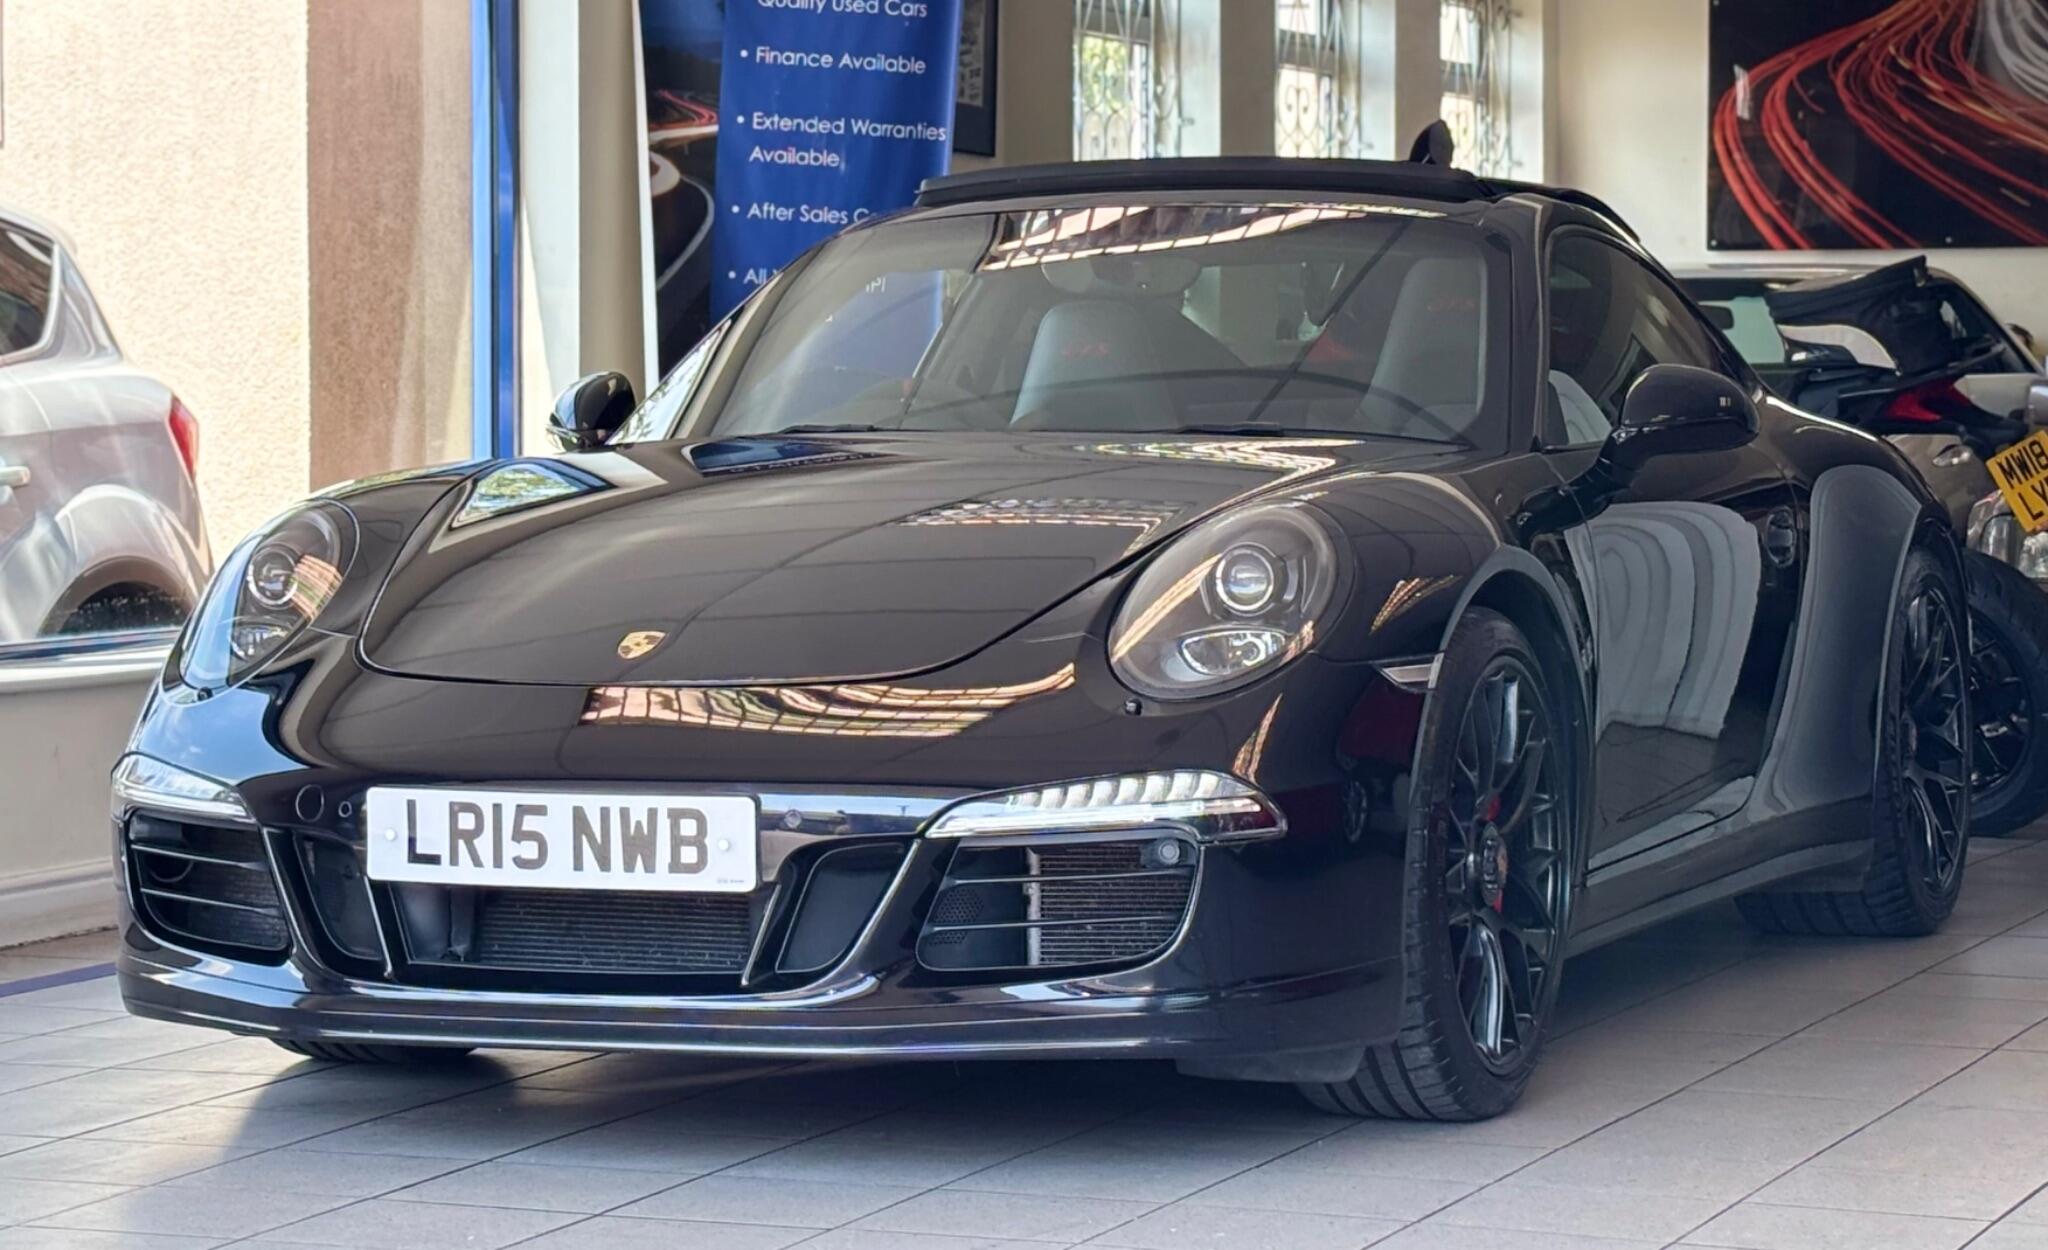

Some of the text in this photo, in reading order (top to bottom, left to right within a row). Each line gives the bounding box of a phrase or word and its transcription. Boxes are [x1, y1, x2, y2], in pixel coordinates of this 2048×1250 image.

[832, 0, 878, 13] Used
[885, 0, 927, 17] Cars
[756, 46, 926, 74] Finance Available
[752, 112, 947, 141] Extended Warranties
[749, 146, 840, 167] Available
[747, 202, 794, 222] After
[800, 204, 848, 224] Sales
[406, 799, 709, 875] LR15 NWB
